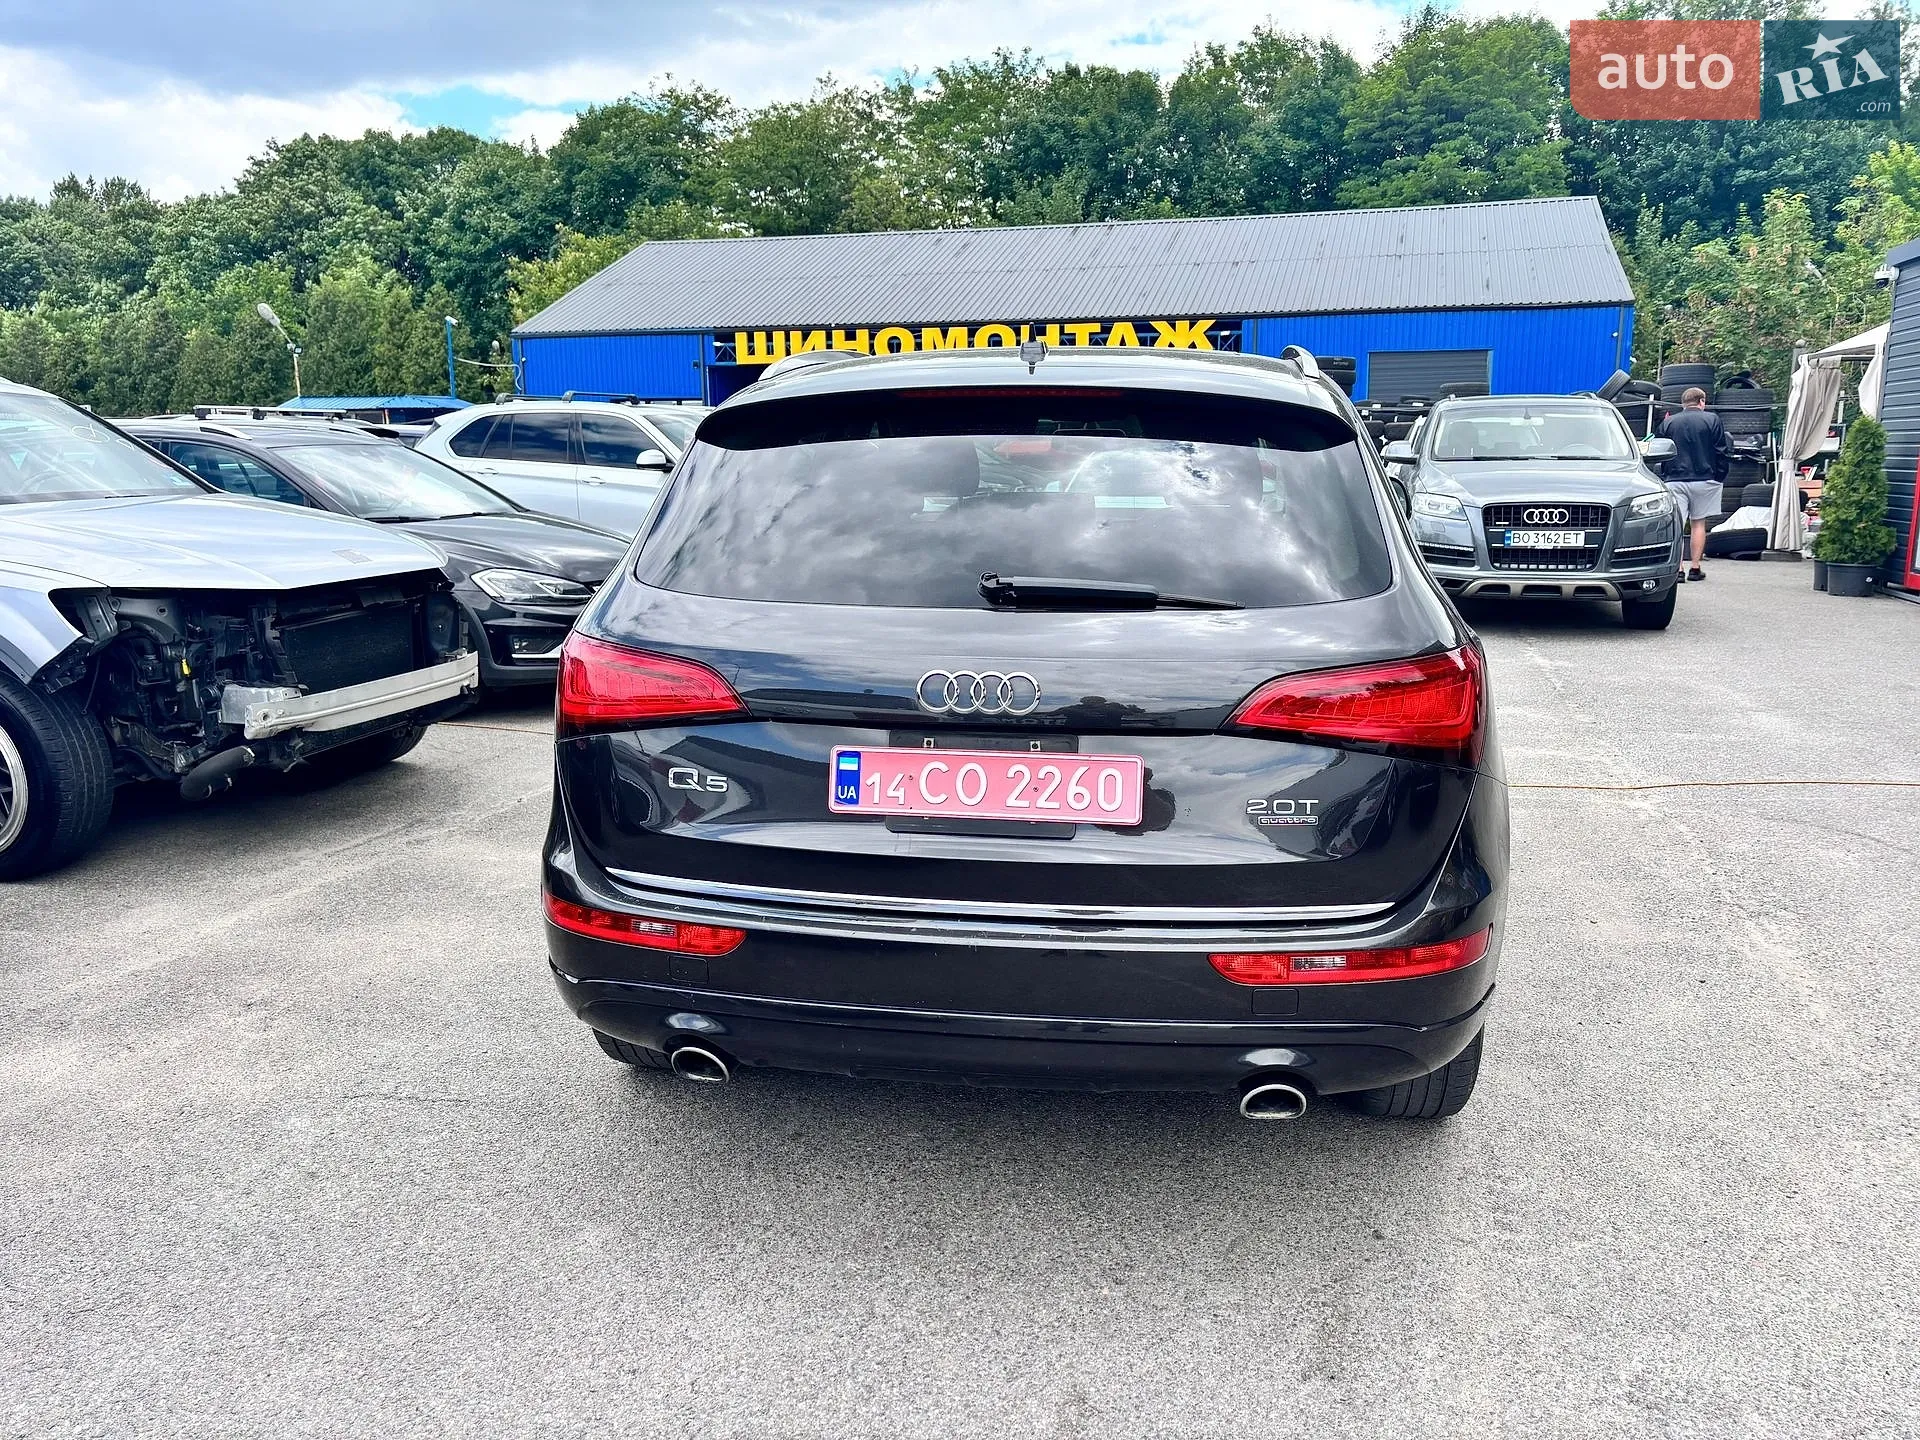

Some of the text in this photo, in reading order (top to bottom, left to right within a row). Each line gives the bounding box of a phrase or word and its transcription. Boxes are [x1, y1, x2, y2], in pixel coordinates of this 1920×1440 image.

[1533, 532, 1560, 544] 3162
[1563, 532, 1581, 544] ET
[668, 767, 728, 792] Q5
[865, 760, 1124, 812] 14 CO 2260
[837, 784, 857, 800] UA
[1246, 799, 1319, 815] 2.0T
[1260, 816, 1316, 825] quattro
